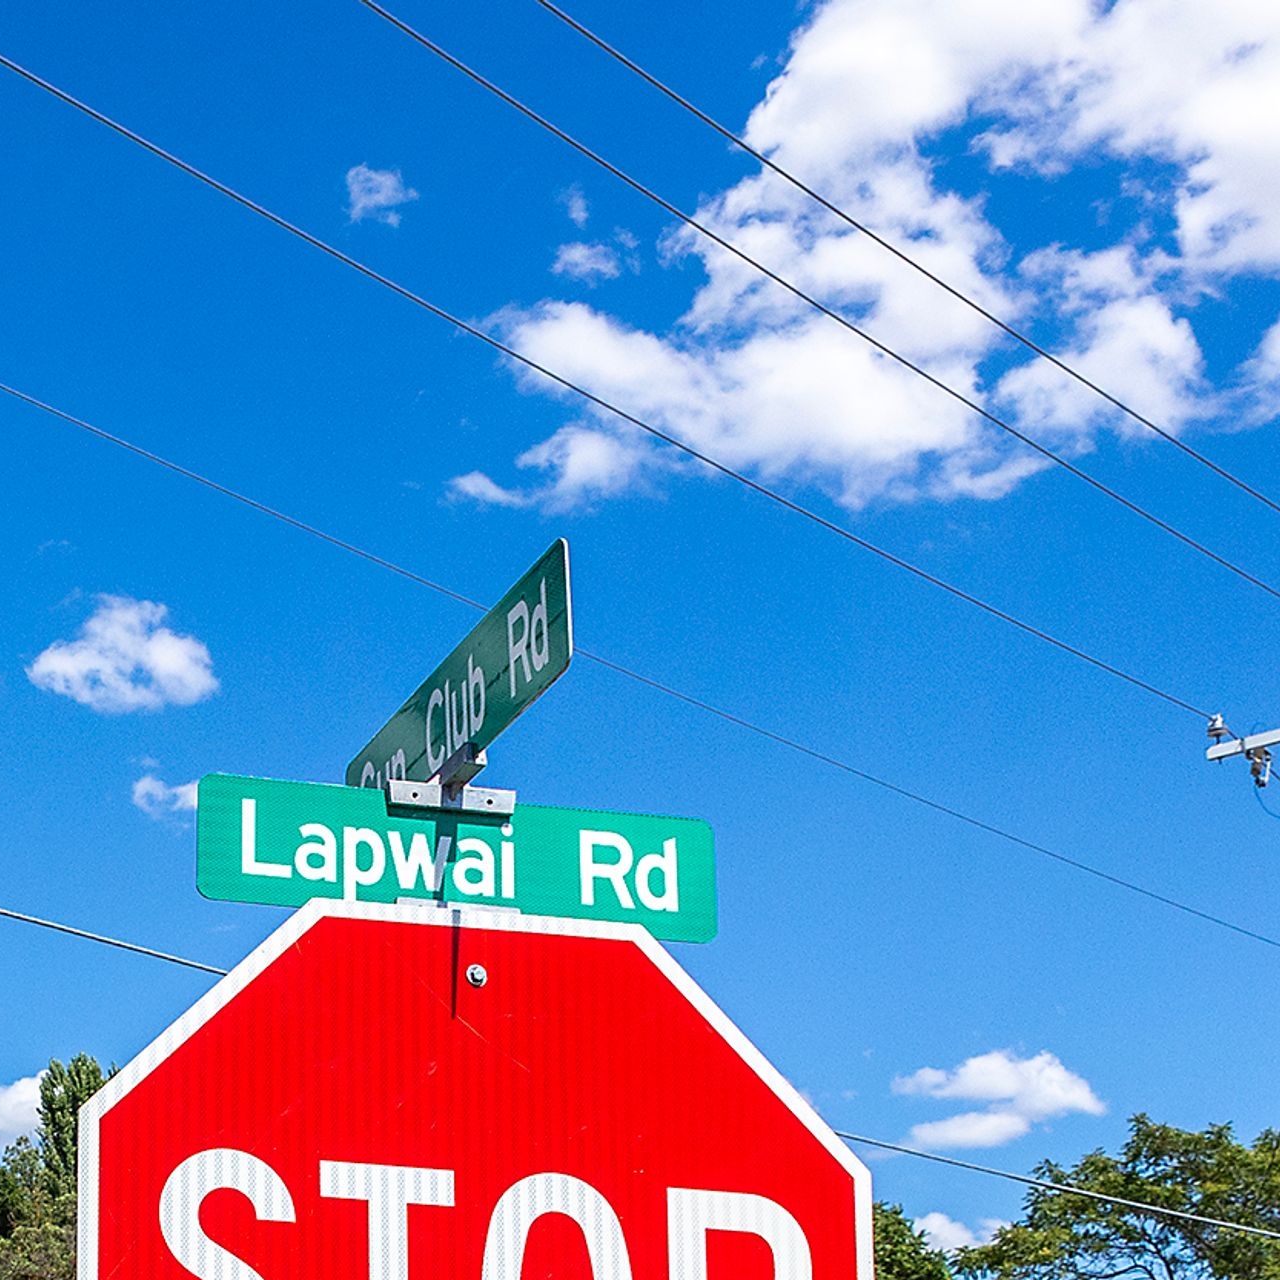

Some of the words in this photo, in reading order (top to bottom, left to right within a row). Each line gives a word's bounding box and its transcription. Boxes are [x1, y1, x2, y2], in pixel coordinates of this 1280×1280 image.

[425, 653, 486, 773] Club
[507, 576, 549, 699] Rd
[241, 798, 516, 900] Lapwai
[579, 828, 679, 913] Rd
